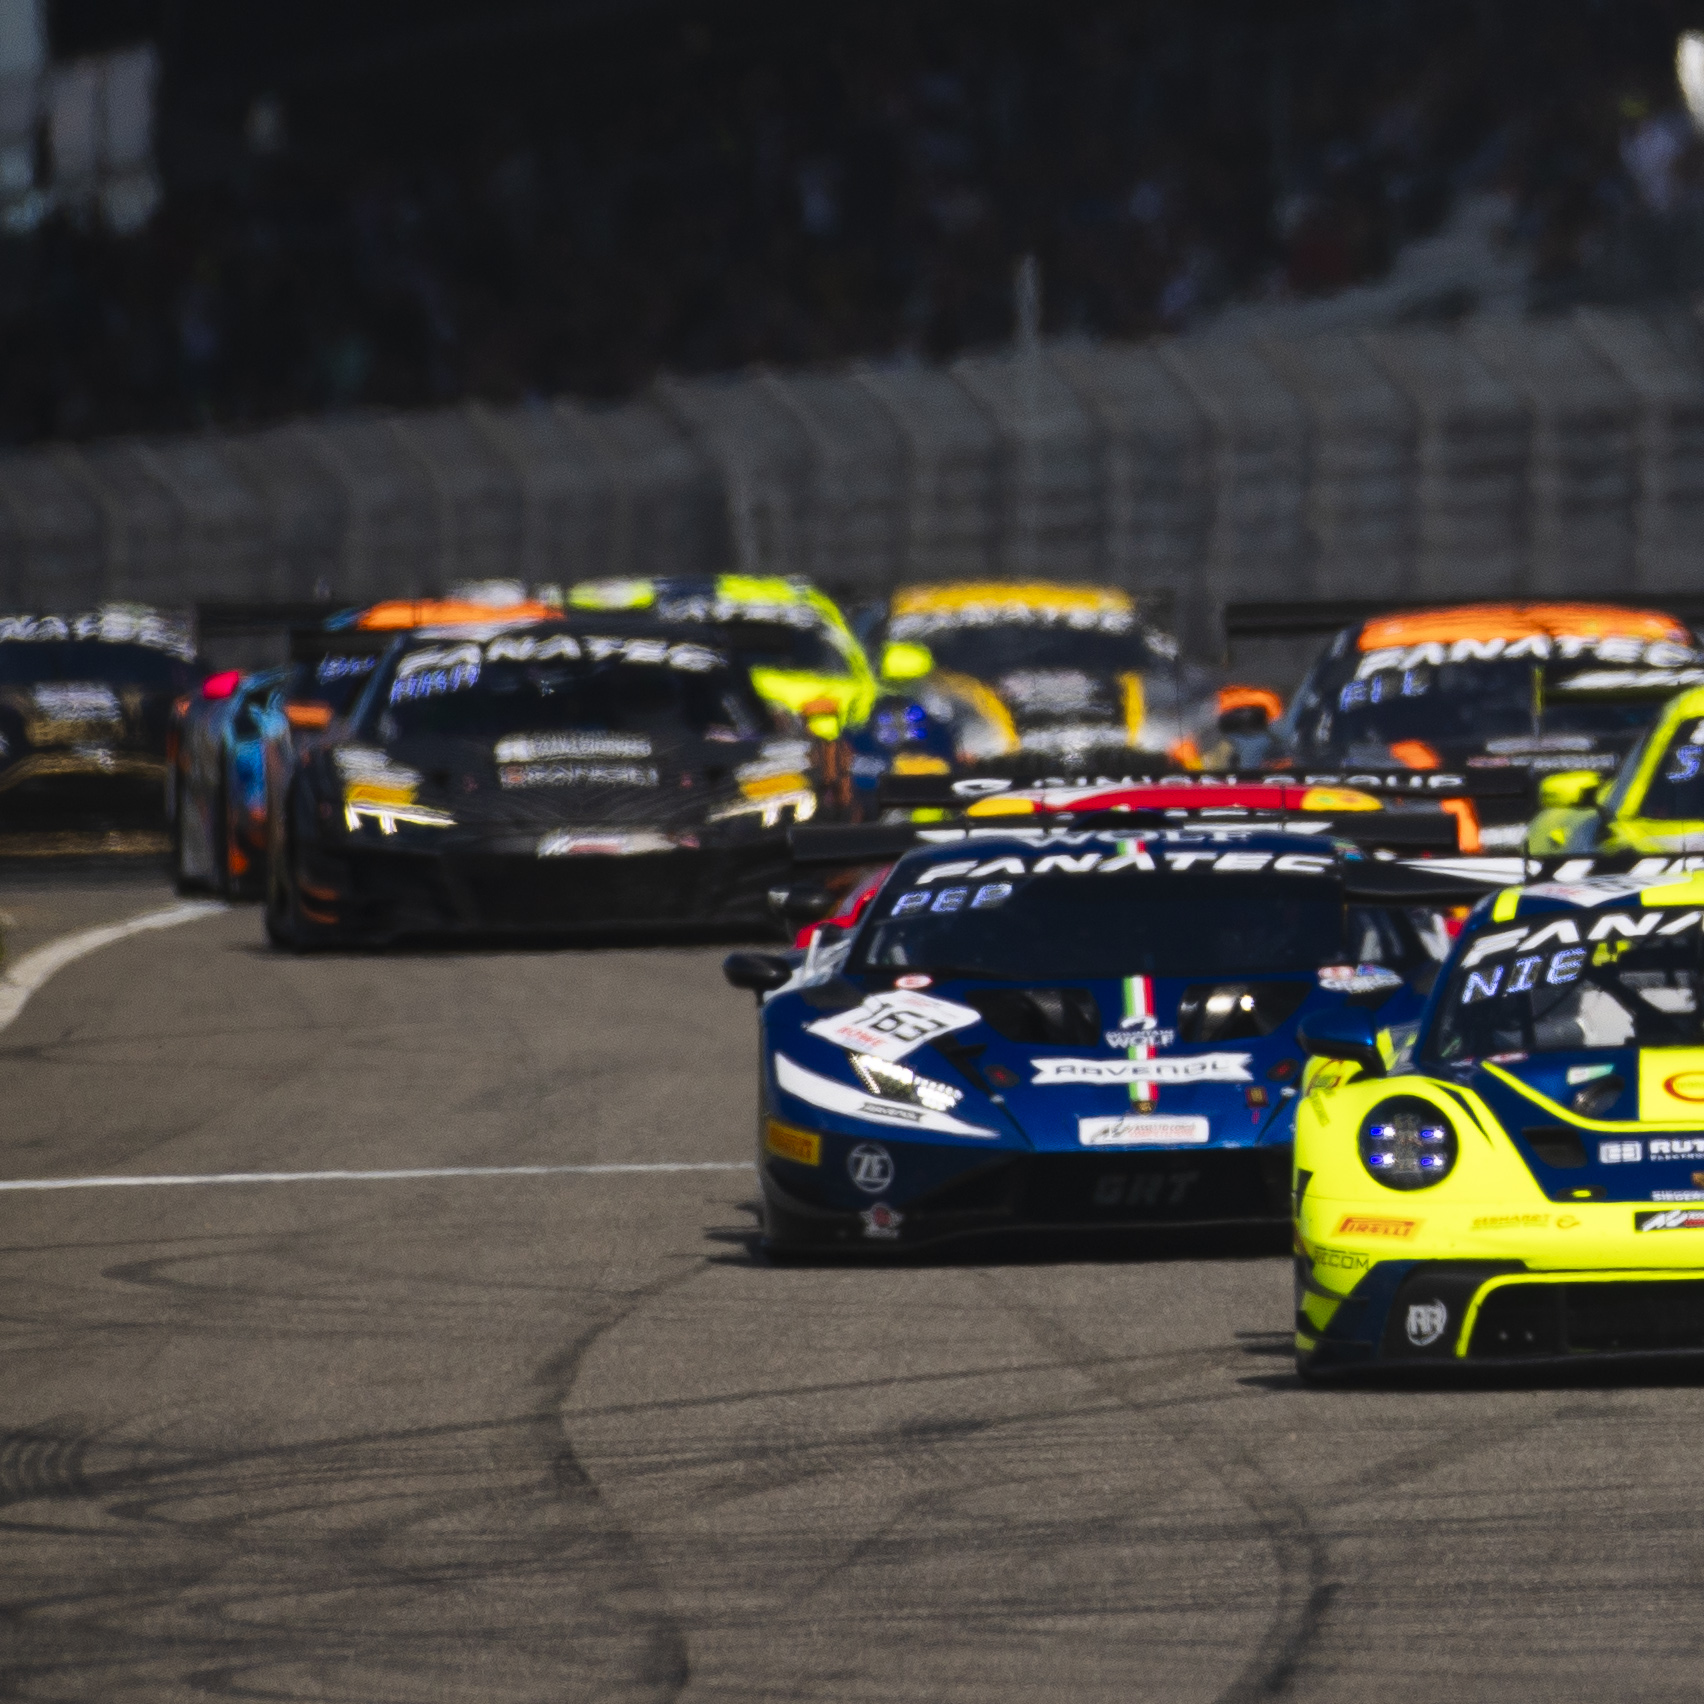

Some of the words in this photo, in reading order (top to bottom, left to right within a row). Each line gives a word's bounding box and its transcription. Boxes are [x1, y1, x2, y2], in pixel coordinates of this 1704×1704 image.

[1355, 635, 1702, 680] FANATEC
[915, 852, 1335, 885] FANATEC
[1462, 946, 1587, 1004] NIE
[853, 1002, 950, 1044] 163
[1055, 1059, 1232, 1077] RAVENOL
[1338, 1216, 1416, 1237] PIRELLI
